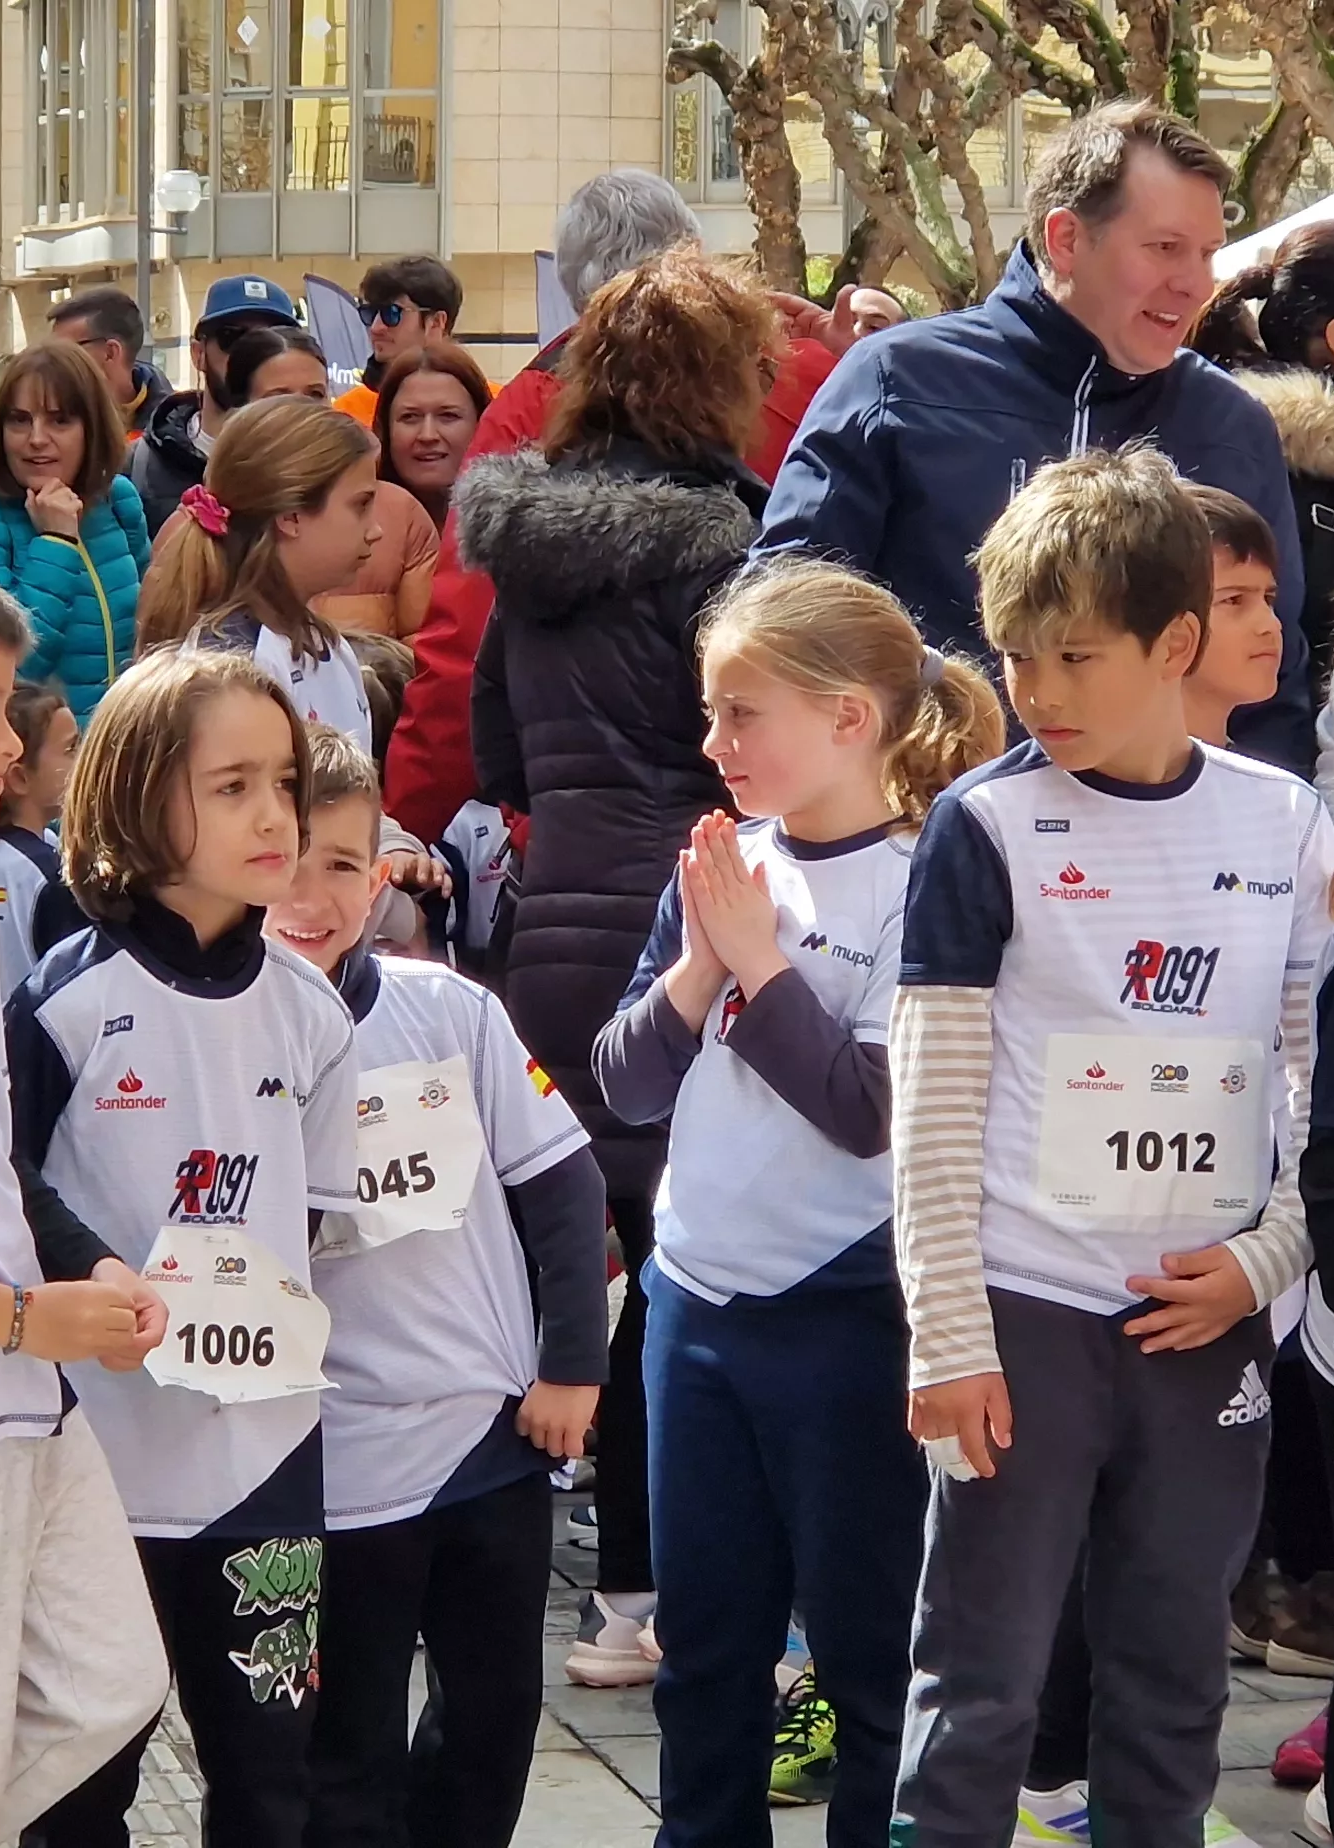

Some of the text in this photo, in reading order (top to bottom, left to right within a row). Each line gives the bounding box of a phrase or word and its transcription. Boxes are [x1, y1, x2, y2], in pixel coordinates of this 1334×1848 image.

[1040, 883, 1111, 900] Santander
[1247, 877, 1294, 899] mupol
[831, 943, 875, 968] mupo
[1120, 939, 1222, 1006] R091
[1066, 1078, 1125, 1092] Santander
[95, 1097, 167, 1111] Santander
[1105, 1130, 1217, 1174] 1012
[167, 1149, 260, 1220] R091
[357, 1151, 436, 1204] 045
[145, 1271, 194, 1284] Santander
[176, 1323, 275, 1367] 1006
